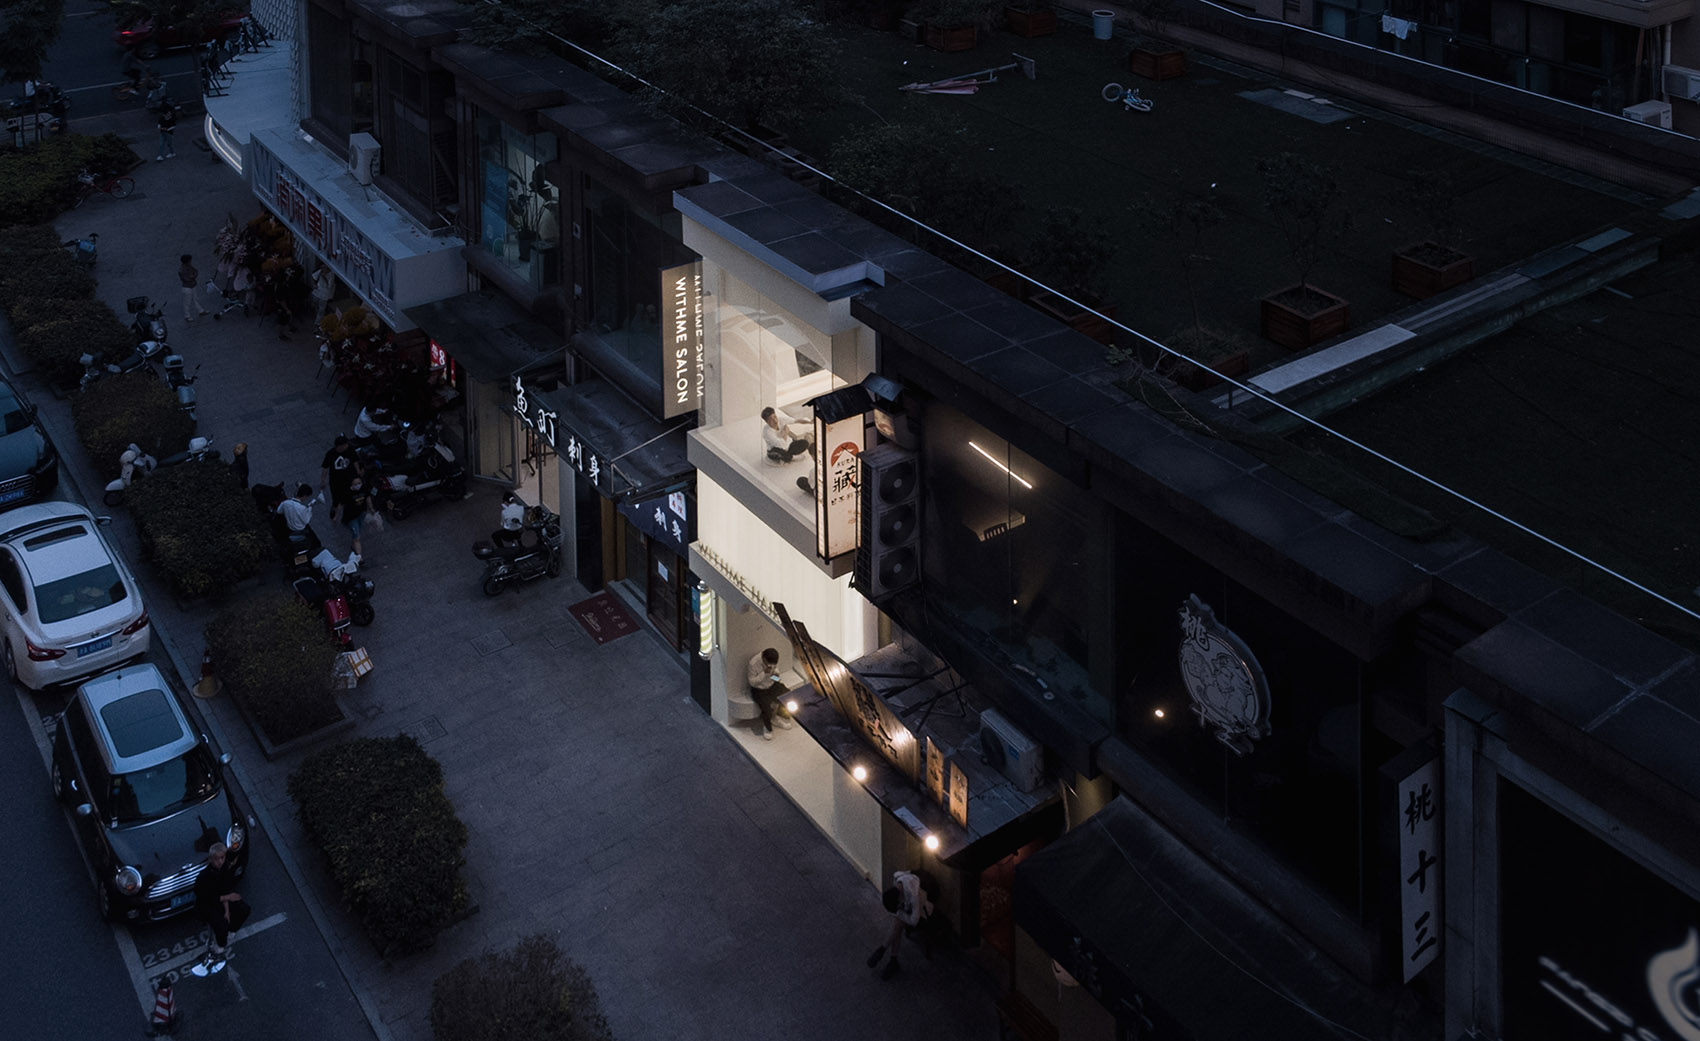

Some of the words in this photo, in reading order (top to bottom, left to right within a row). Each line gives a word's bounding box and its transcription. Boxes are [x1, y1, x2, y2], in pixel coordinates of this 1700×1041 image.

[675, 276, 687, 344] WITHME
[676, 348, 688, 404] SALON
[1404, 783, 1437, 962] 桃十三
